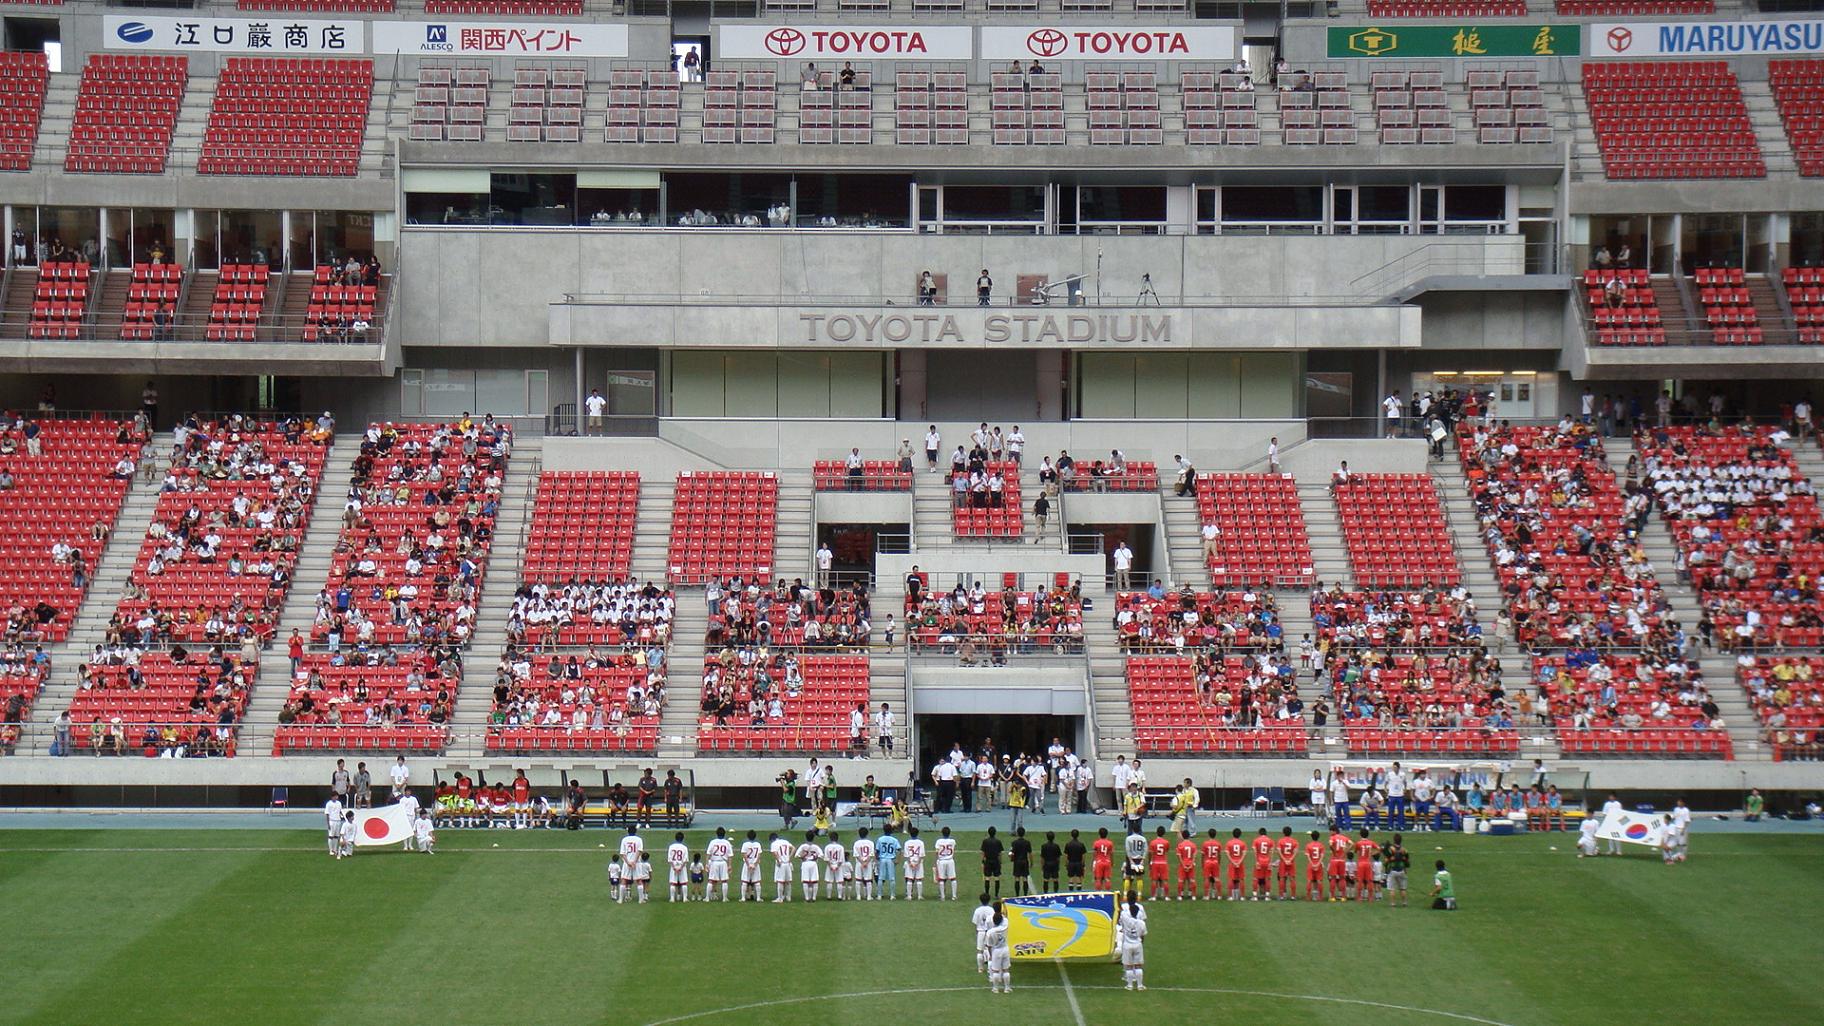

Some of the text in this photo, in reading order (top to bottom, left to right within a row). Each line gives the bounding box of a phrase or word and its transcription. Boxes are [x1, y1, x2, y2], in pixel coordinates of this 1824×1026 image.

[461, 28, 582, 51] 関西ペイント
[812, 31, 927, 53] TOYOTA
[1074, 32, 1189, 54] TOYOTA
[1658, 23, 1822, 53] MARUYASU
[420, 43, 453, 51] ALESCO
[800, 313, 1172, 343] TOYOTA STADIUM
[713, 845, 727, 856] 29
[779, 845, 788, 855] 17
[881, 842, 894, 854] 36
[940, 845, 953, 856] 25
[1100, 844, 1108, 856] 4
[1132, 840, 1144, 851] 18
[1156, 844, 1165, 855] 5
[1233, 844, 1241, 856] 9
[1260, 842, 1268, 854] 6
[1283, 843, 1292, 854] 2
[671, 850, 683, 861] 28
[747, 848, 759, 859] 27
[829, 850, 839, 861] 14
[860, 846, 870, 857] 19
[908, 846, 920, 857] 34
[1184, 846, 1192, 858] 7
[1207, 846, 1219, 858] 15
[1311, 847, 1320, 859] 3
